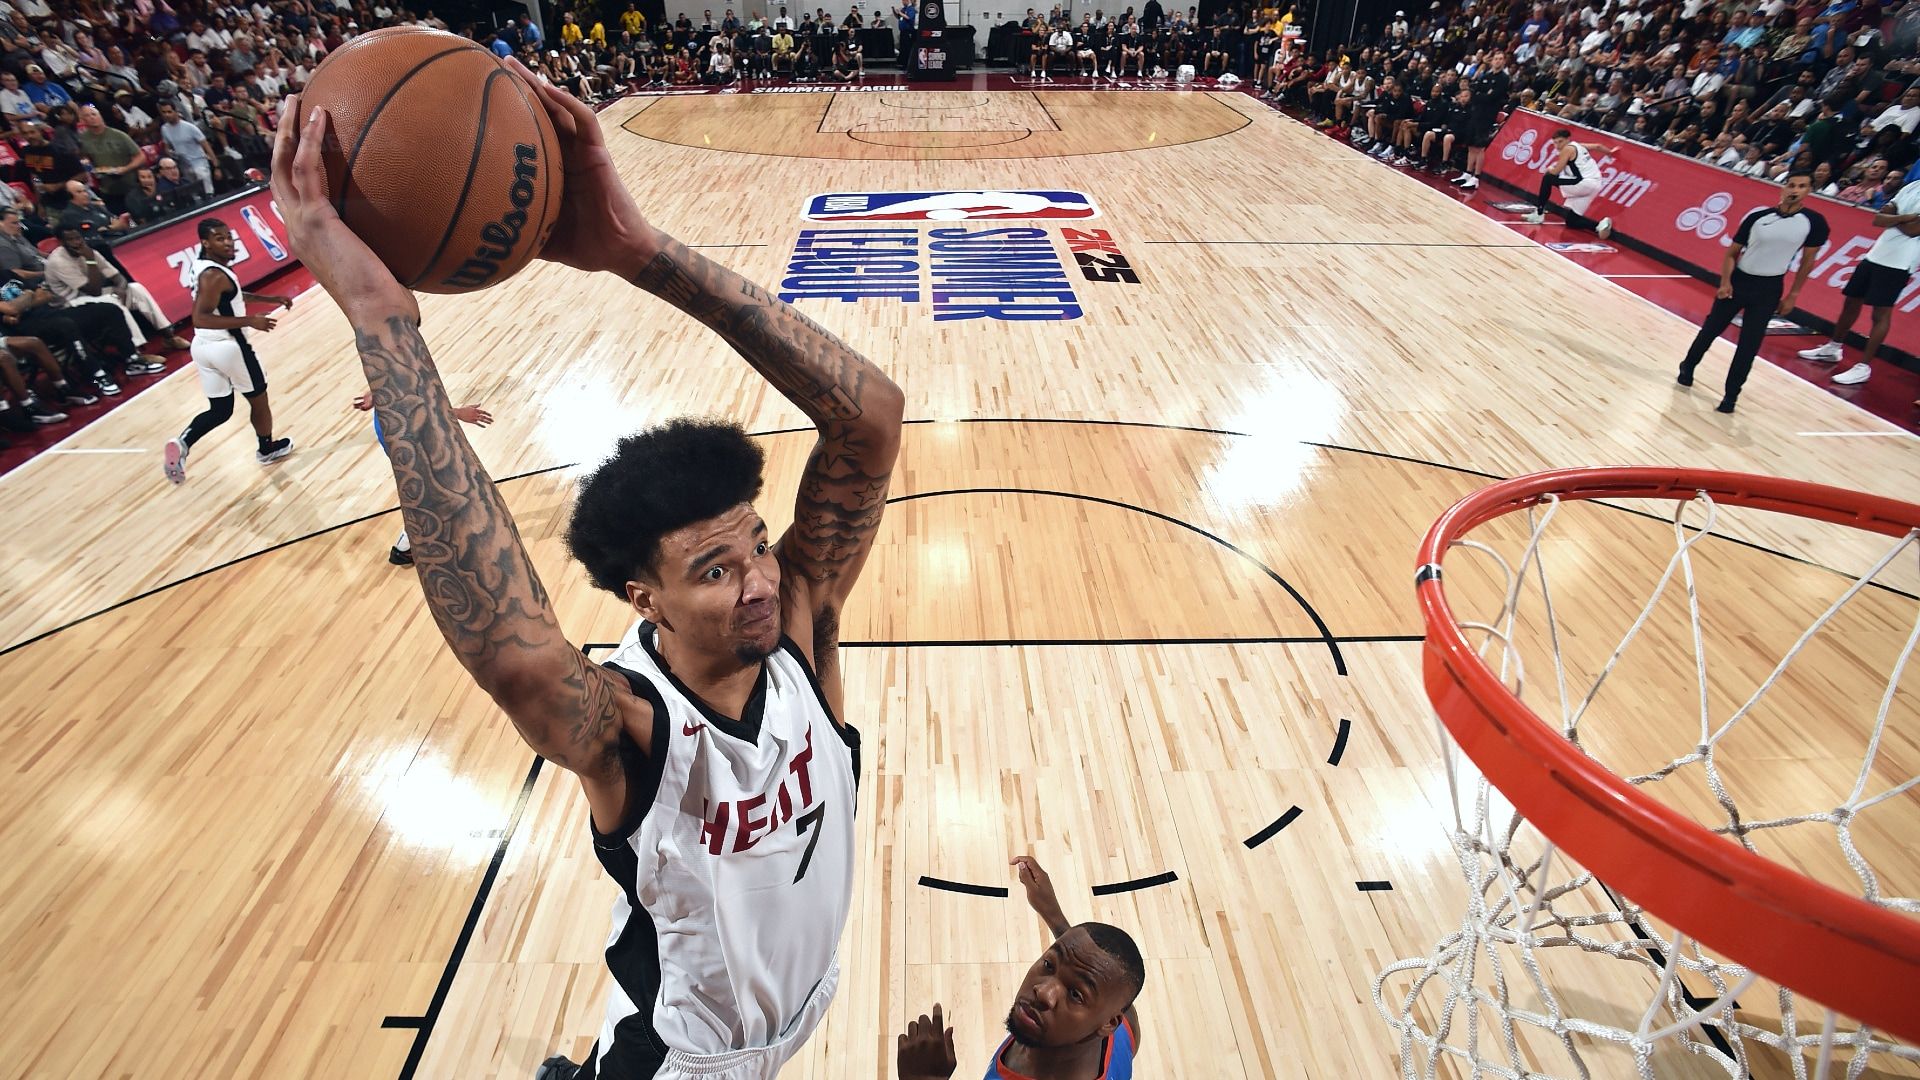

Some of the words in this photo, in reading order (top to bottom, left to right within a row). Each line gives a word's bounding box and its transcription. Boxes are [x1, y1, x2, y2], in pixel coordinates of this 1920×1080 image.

[441, 143, 537, 288] Wilson
[1060, 228, 1141, 284] 2K25
[777, 229, 920, 303] LEAGUE
[927, 228, 1084, 321] SUMMER
[700, 720, 813, 856] HEAT
[792, 800, 825, 885] 7
